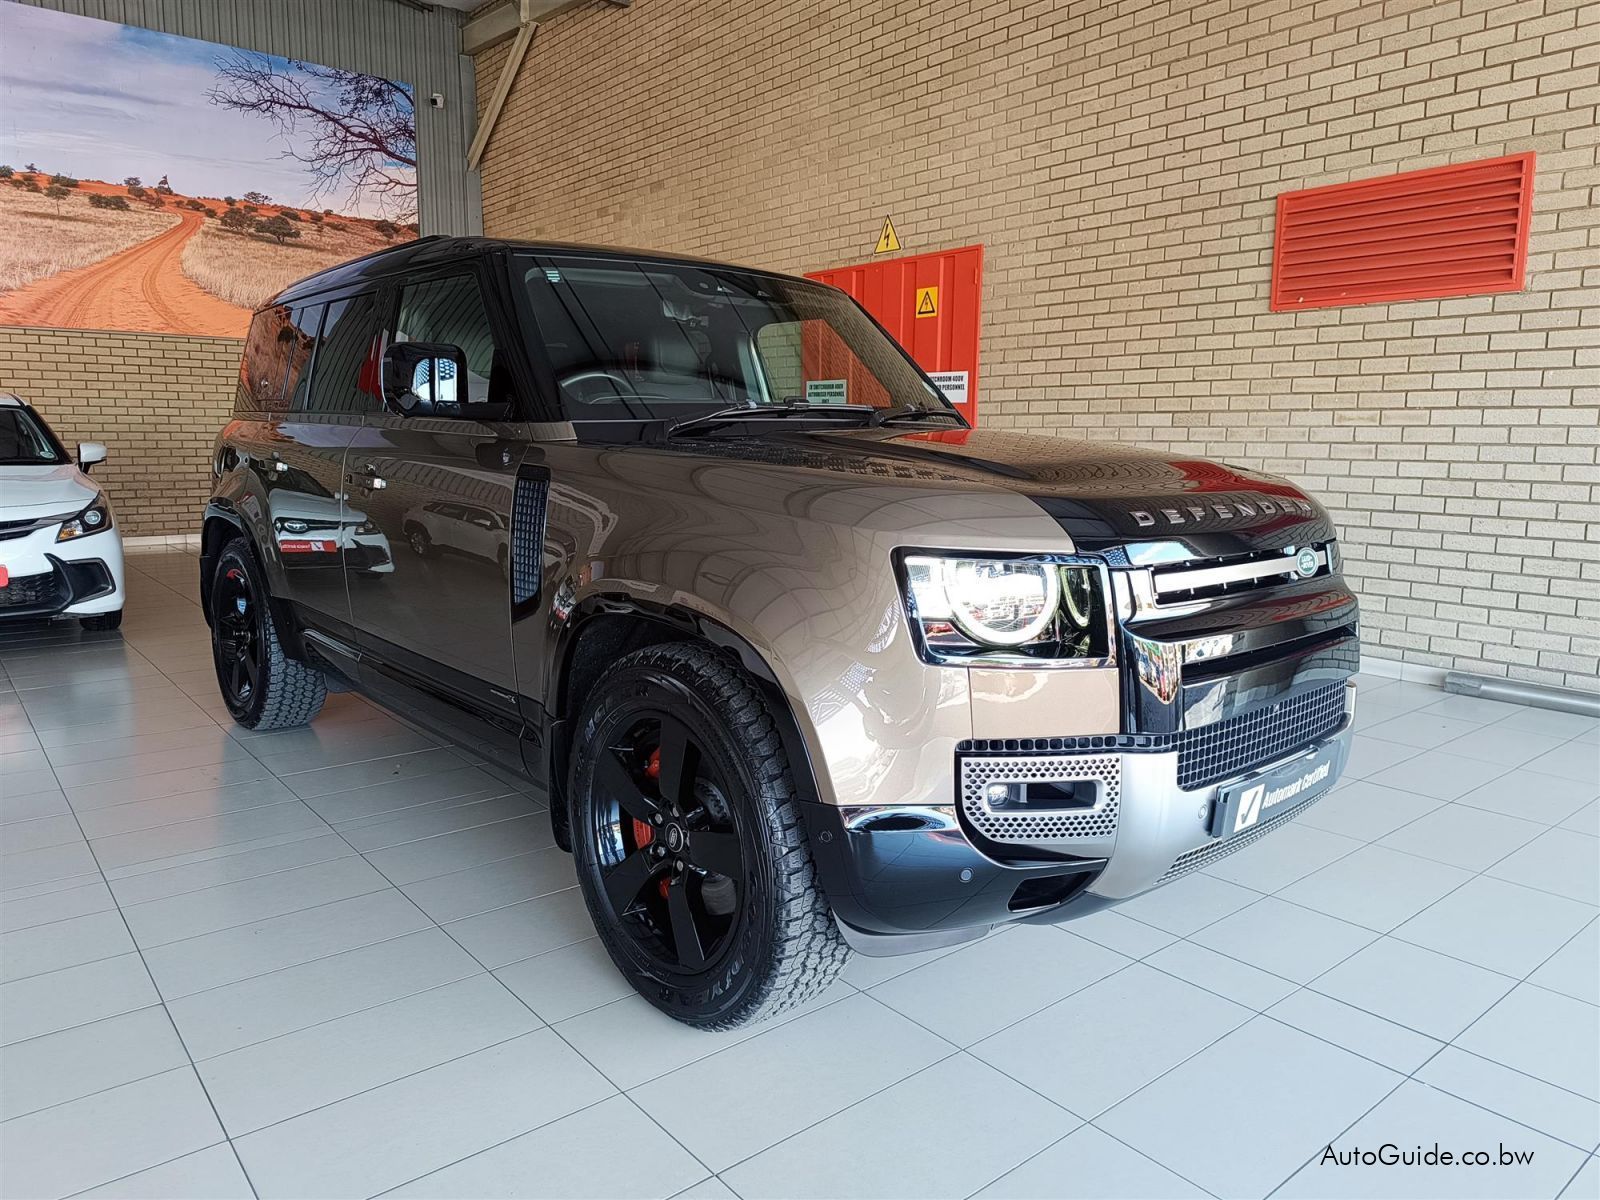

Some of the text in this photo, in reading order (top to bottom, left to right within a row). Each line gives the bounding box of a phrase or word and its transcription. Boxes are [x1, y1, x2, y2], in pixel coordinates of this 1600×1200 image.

[1129, 498, 1313, 527] DEFENDER
[1261, 760, 1331, 810] Automark Certified
